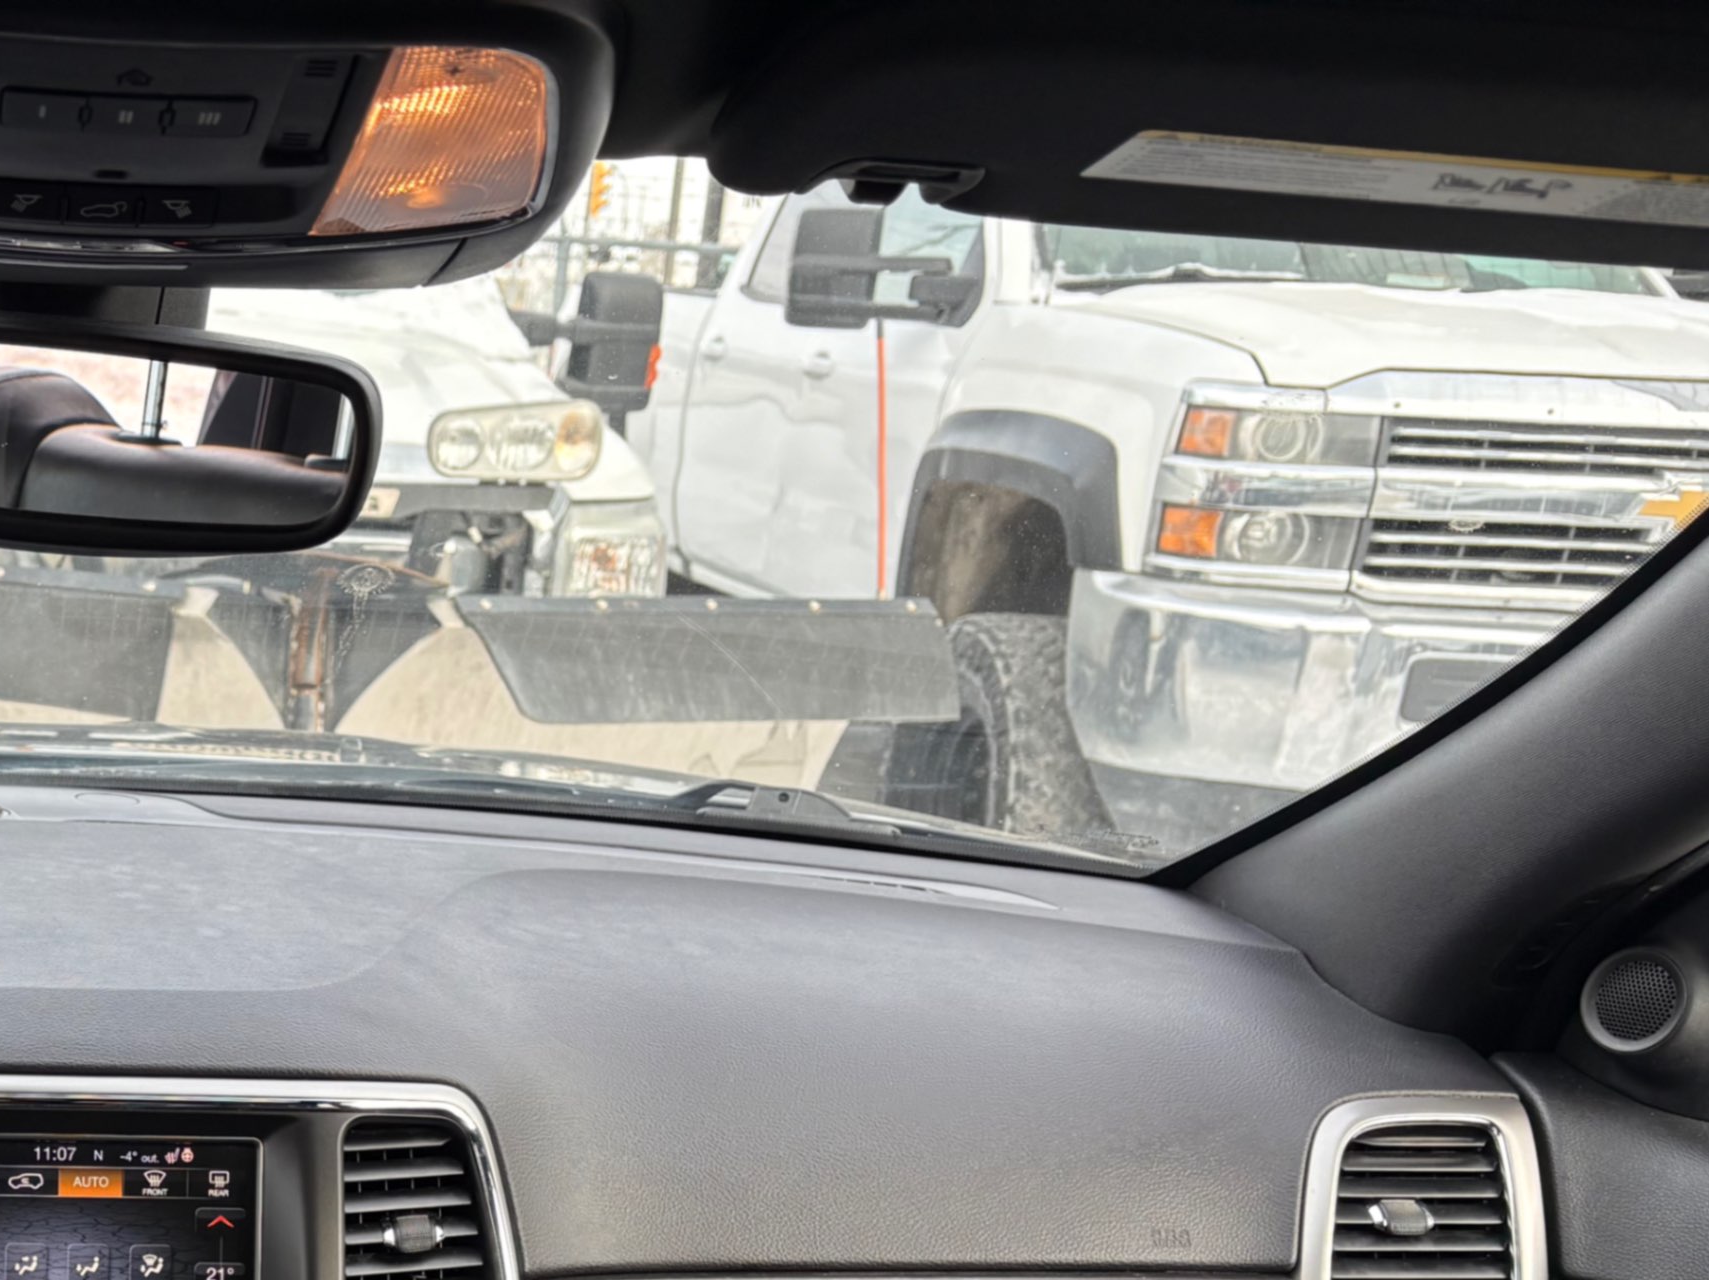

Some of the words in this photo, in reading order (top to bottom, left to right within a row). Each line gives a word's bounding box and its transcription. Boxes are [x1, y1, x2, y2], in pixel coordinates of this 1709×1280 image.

[33, 1147, 77, 1161] 11:07
[93, 1149, 104, 1161] N
[72, 1175, 109, 1188] AUTO
[142, 1187, 168, 1197] FRONT
[208, 1189, 229, 1198] REAR
